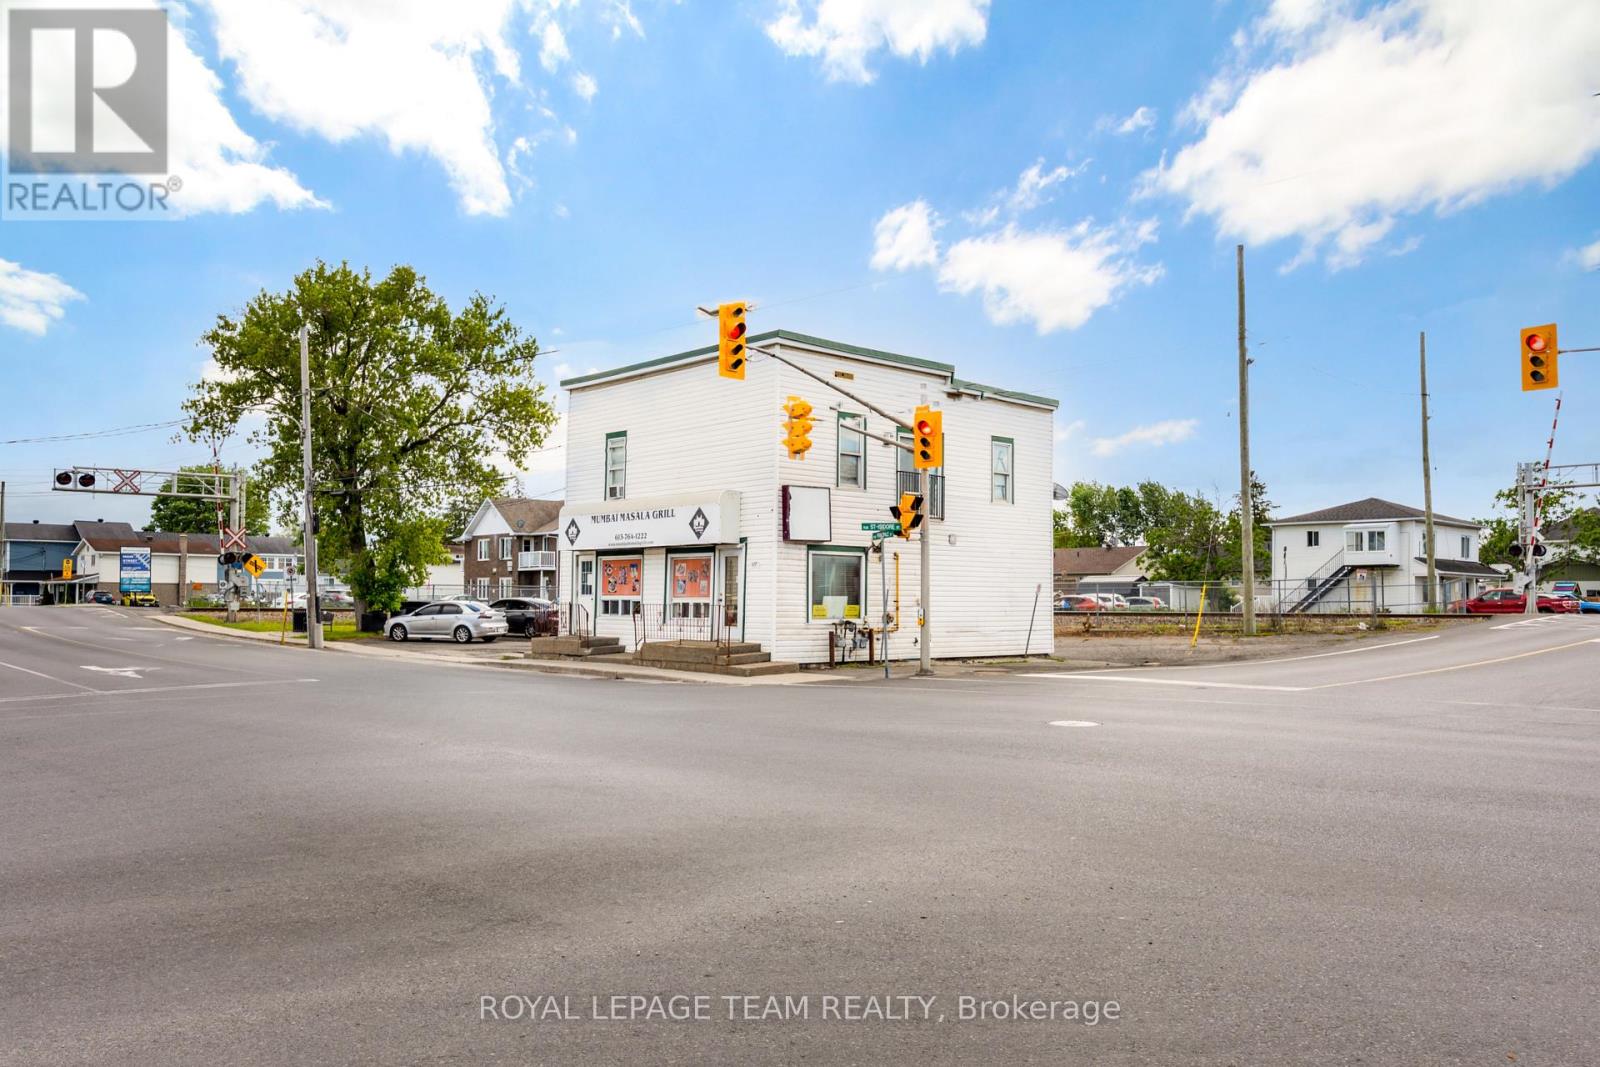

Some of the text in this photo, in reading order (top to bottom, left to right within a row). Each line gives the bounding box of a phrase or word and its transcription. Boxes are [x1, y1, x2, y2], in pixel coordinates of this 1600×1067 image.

[591, 508, 675, 524] MUMBAI MASALA GRILL
